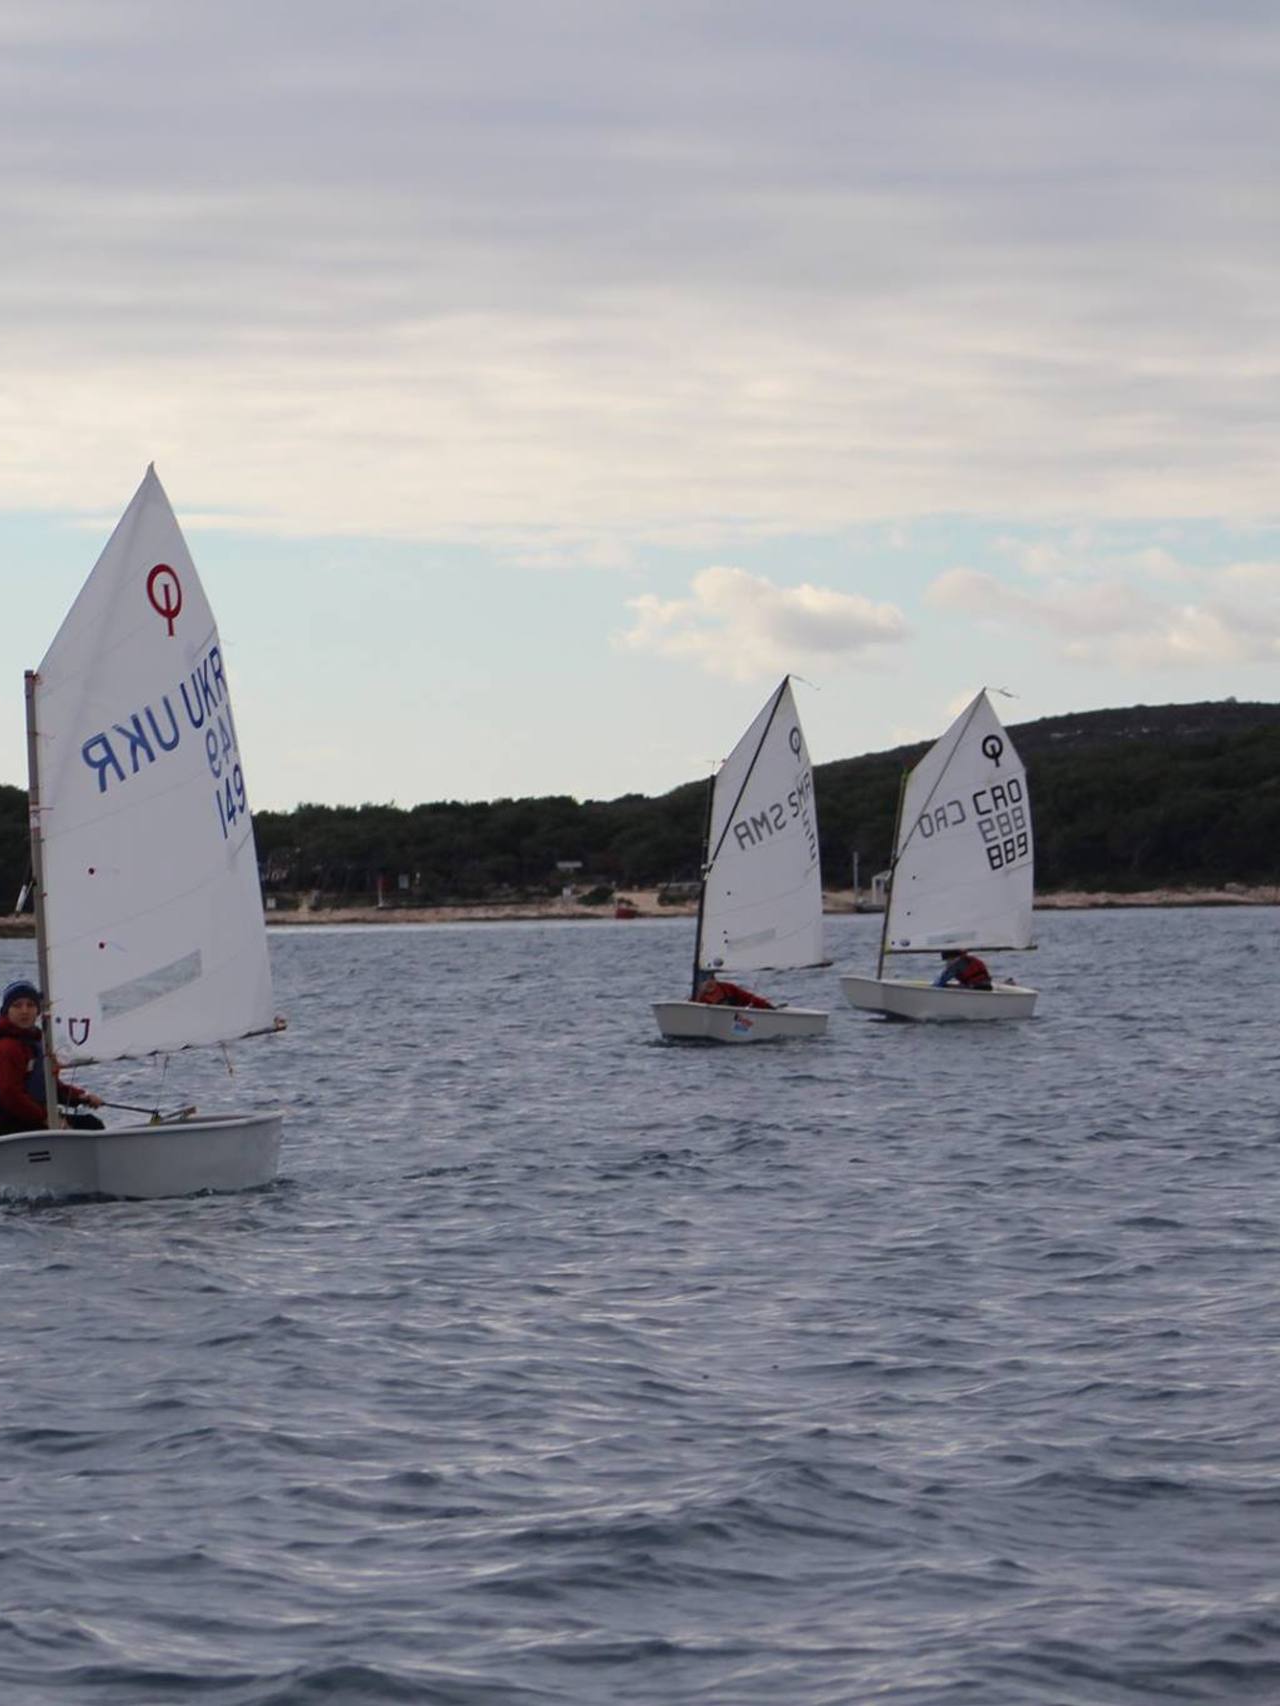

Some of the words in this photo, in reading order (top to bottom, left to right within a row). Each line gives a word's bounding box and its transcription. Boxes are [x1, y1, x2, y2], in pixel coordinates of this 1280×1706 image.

[180, 645, 228, 730] UKR
[216, 763, 247, 840] 149
[986, 831, 1029, 871] 889
